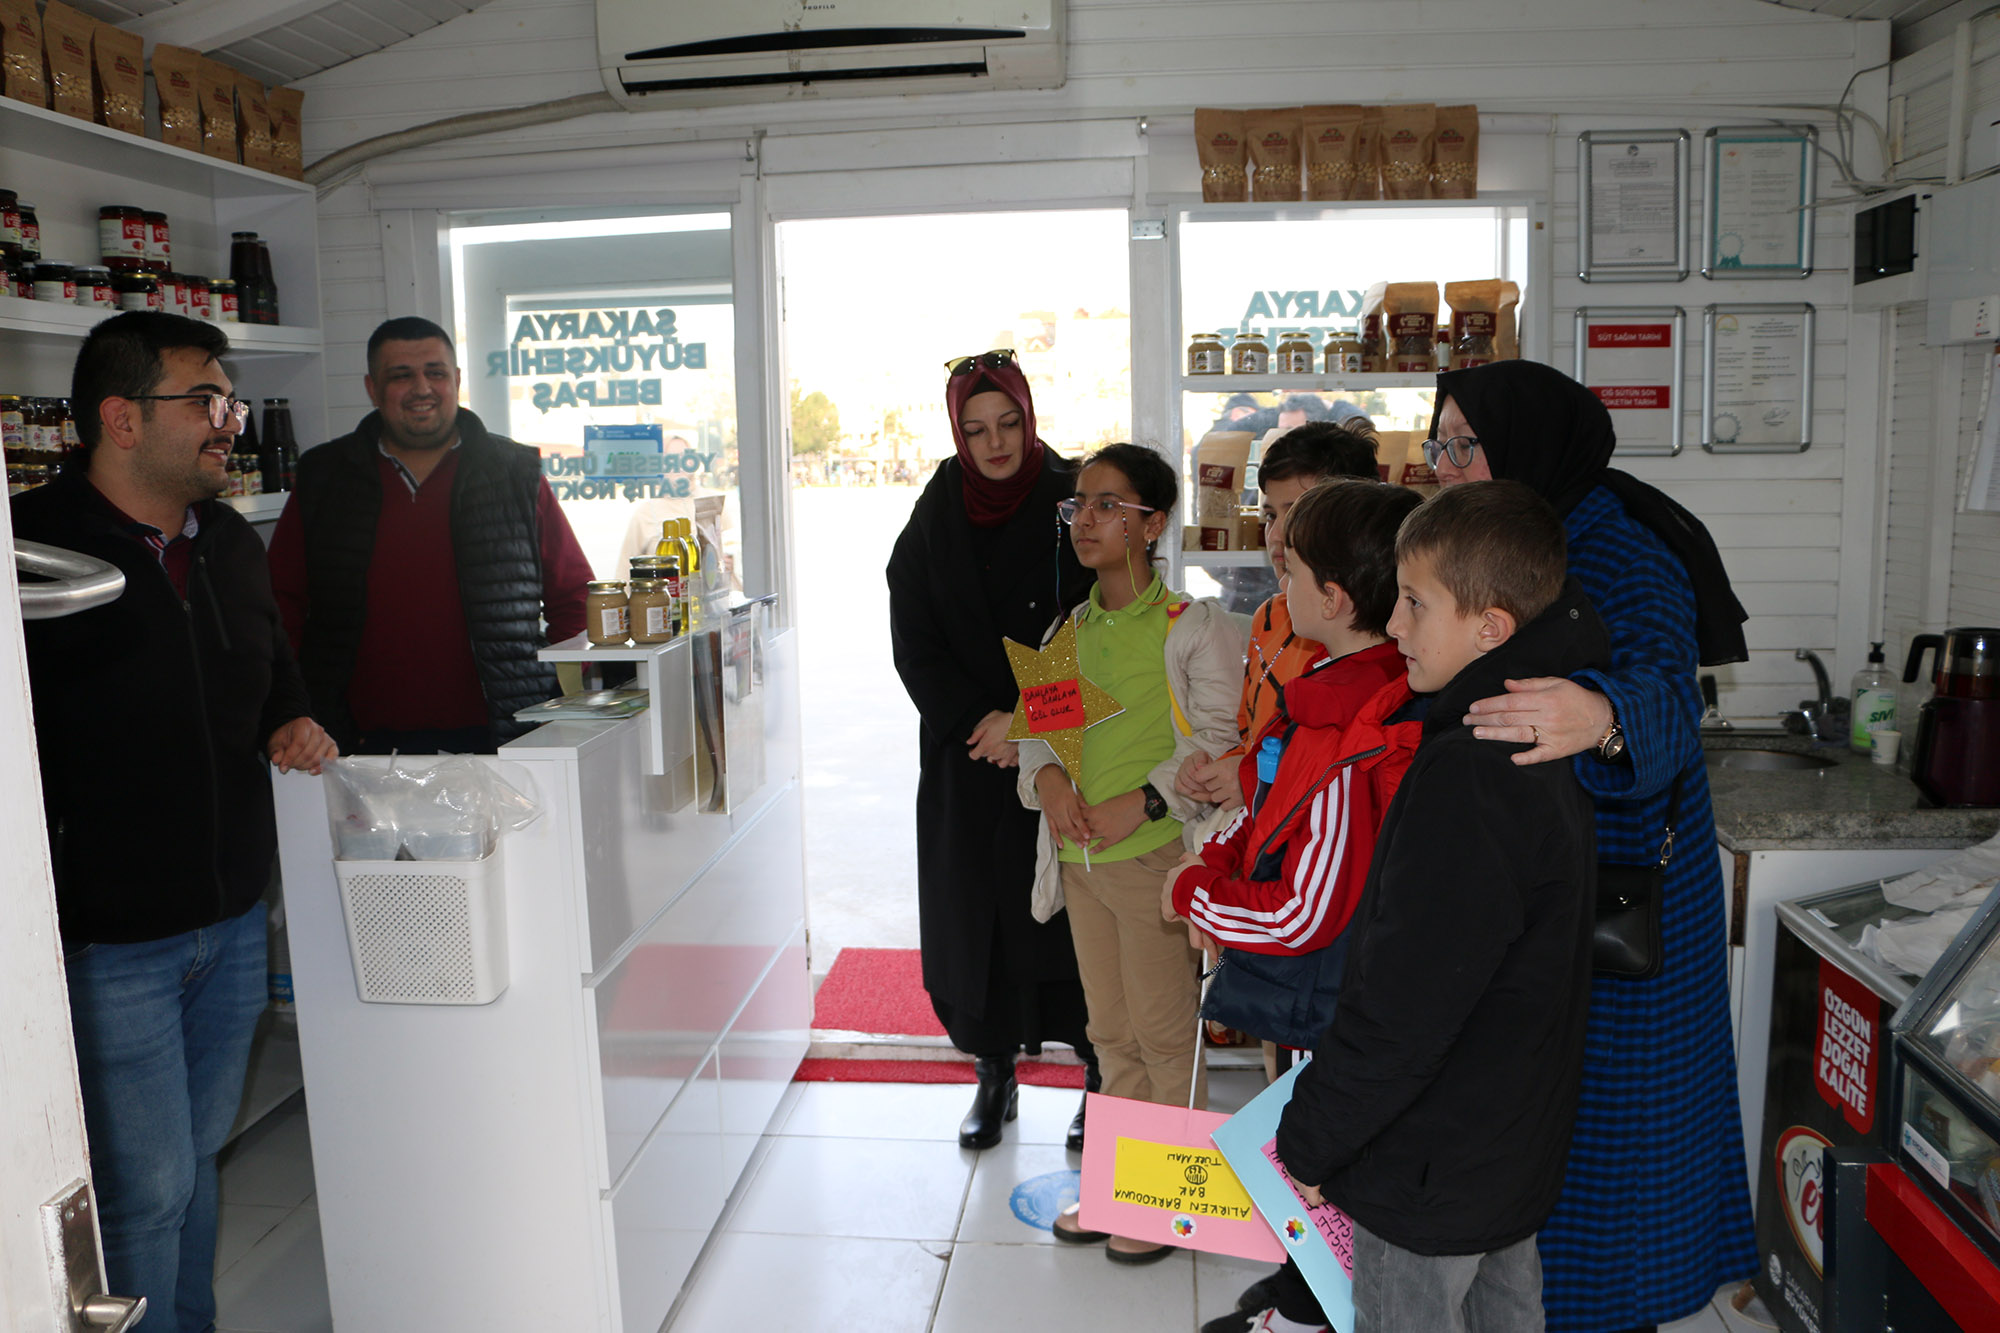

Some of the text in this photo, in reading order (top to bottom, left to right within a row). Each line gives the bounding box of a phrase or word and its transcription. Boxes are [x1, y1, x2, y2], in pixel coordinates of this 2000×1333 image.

[1823, 986, 1871, 1043] ÖZGÜN
[1823, 1010, 1870, 1067] LEZZET
[1819, 1056, 1867, 1117] KALİTE
[1821, 1033, 1868, 1092] DOĞAL
[1194, 1155, 1222, 1167] TÜRK
[1114, 1188, 1250, 1218] ALIRKEN BARKODUNA
[1178, 1185, 1206, 1199] BAK
